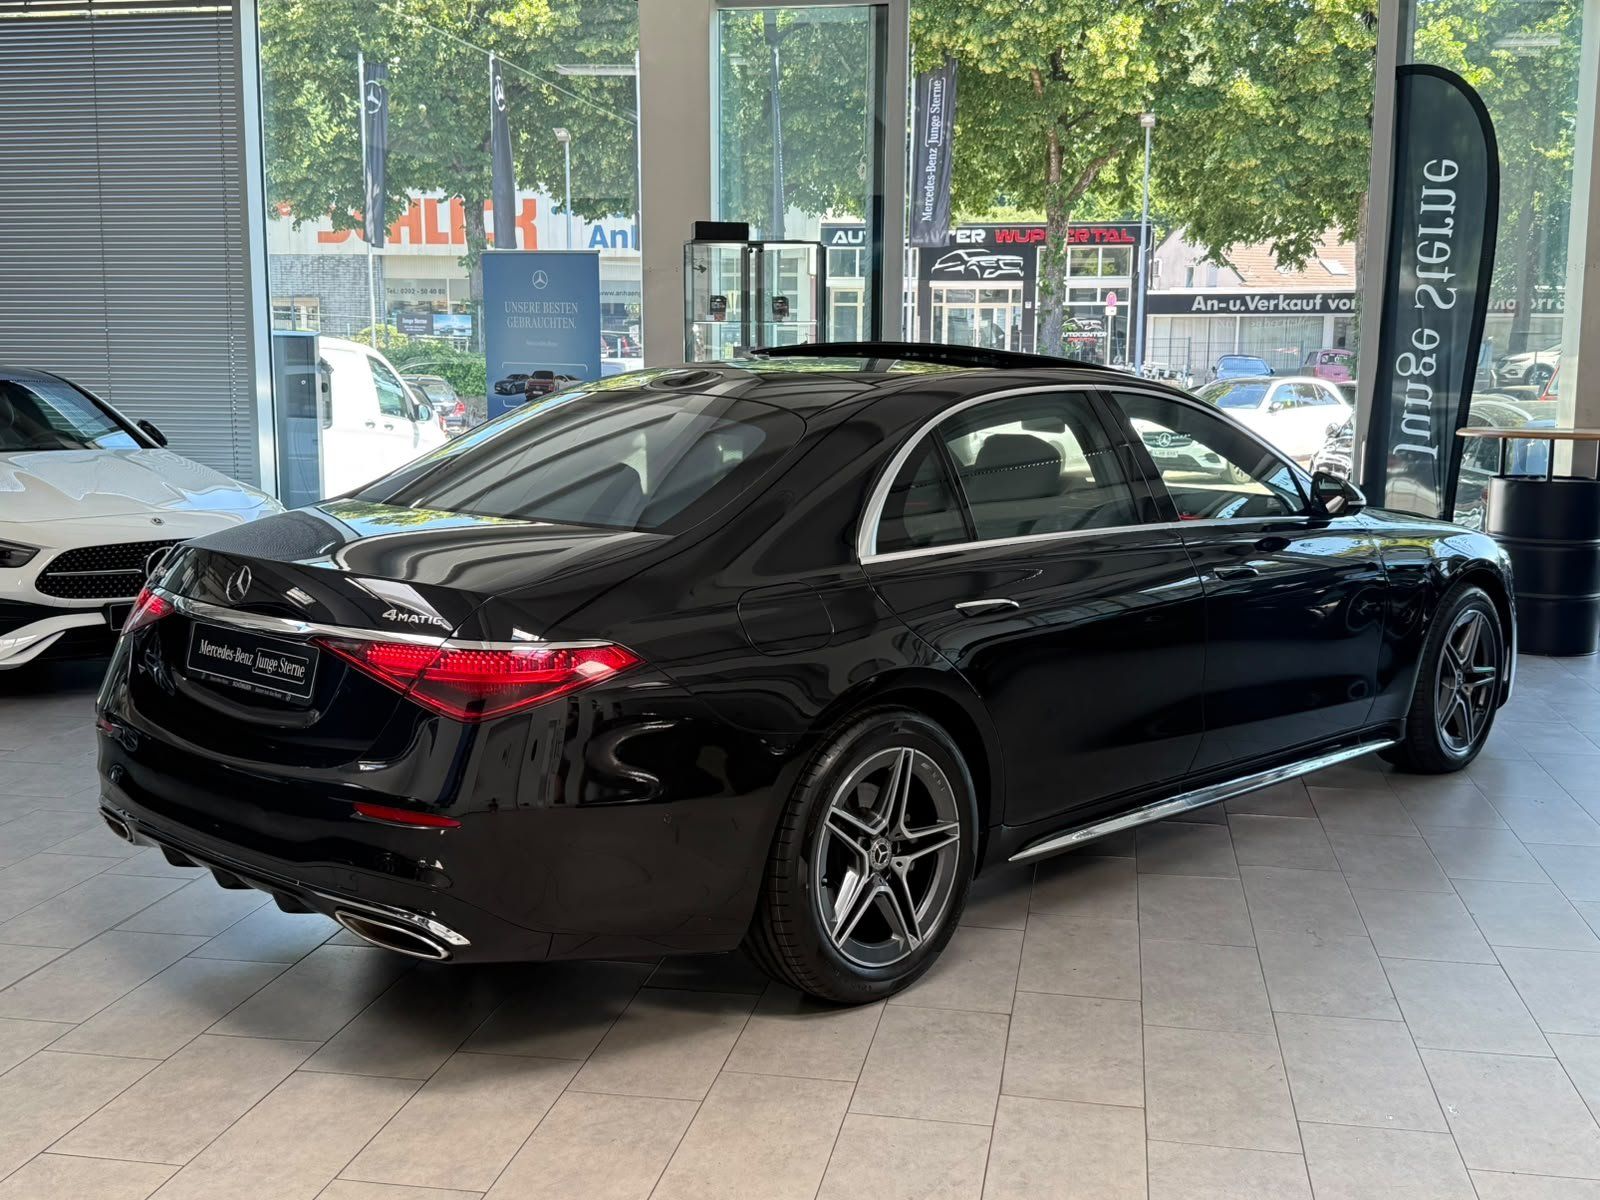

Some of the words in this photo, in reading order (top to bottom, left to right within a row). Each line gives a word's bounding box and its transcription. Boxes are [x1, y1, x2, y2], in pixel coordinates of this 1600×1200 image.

[930, 80, 942, 114] Sterne
[928, 115, 940, 144] Junge
[921, 147, 938, 222] Mercedes-Benz
[994, 228, 1135, 243] WUPERTAL
[504, 301, 541, 313] UNSERE
[543, 302, 579, 314] BESTEN
[506, 316, 577, 329] GEBRAUCHTEN.
[382, 609, 444, 626] 4MATIC
[199, 639, 254, 666] Mercedes-Benz
[254, 651, 278, 674] Junge
[278, 657, 306, 678] Sterne
